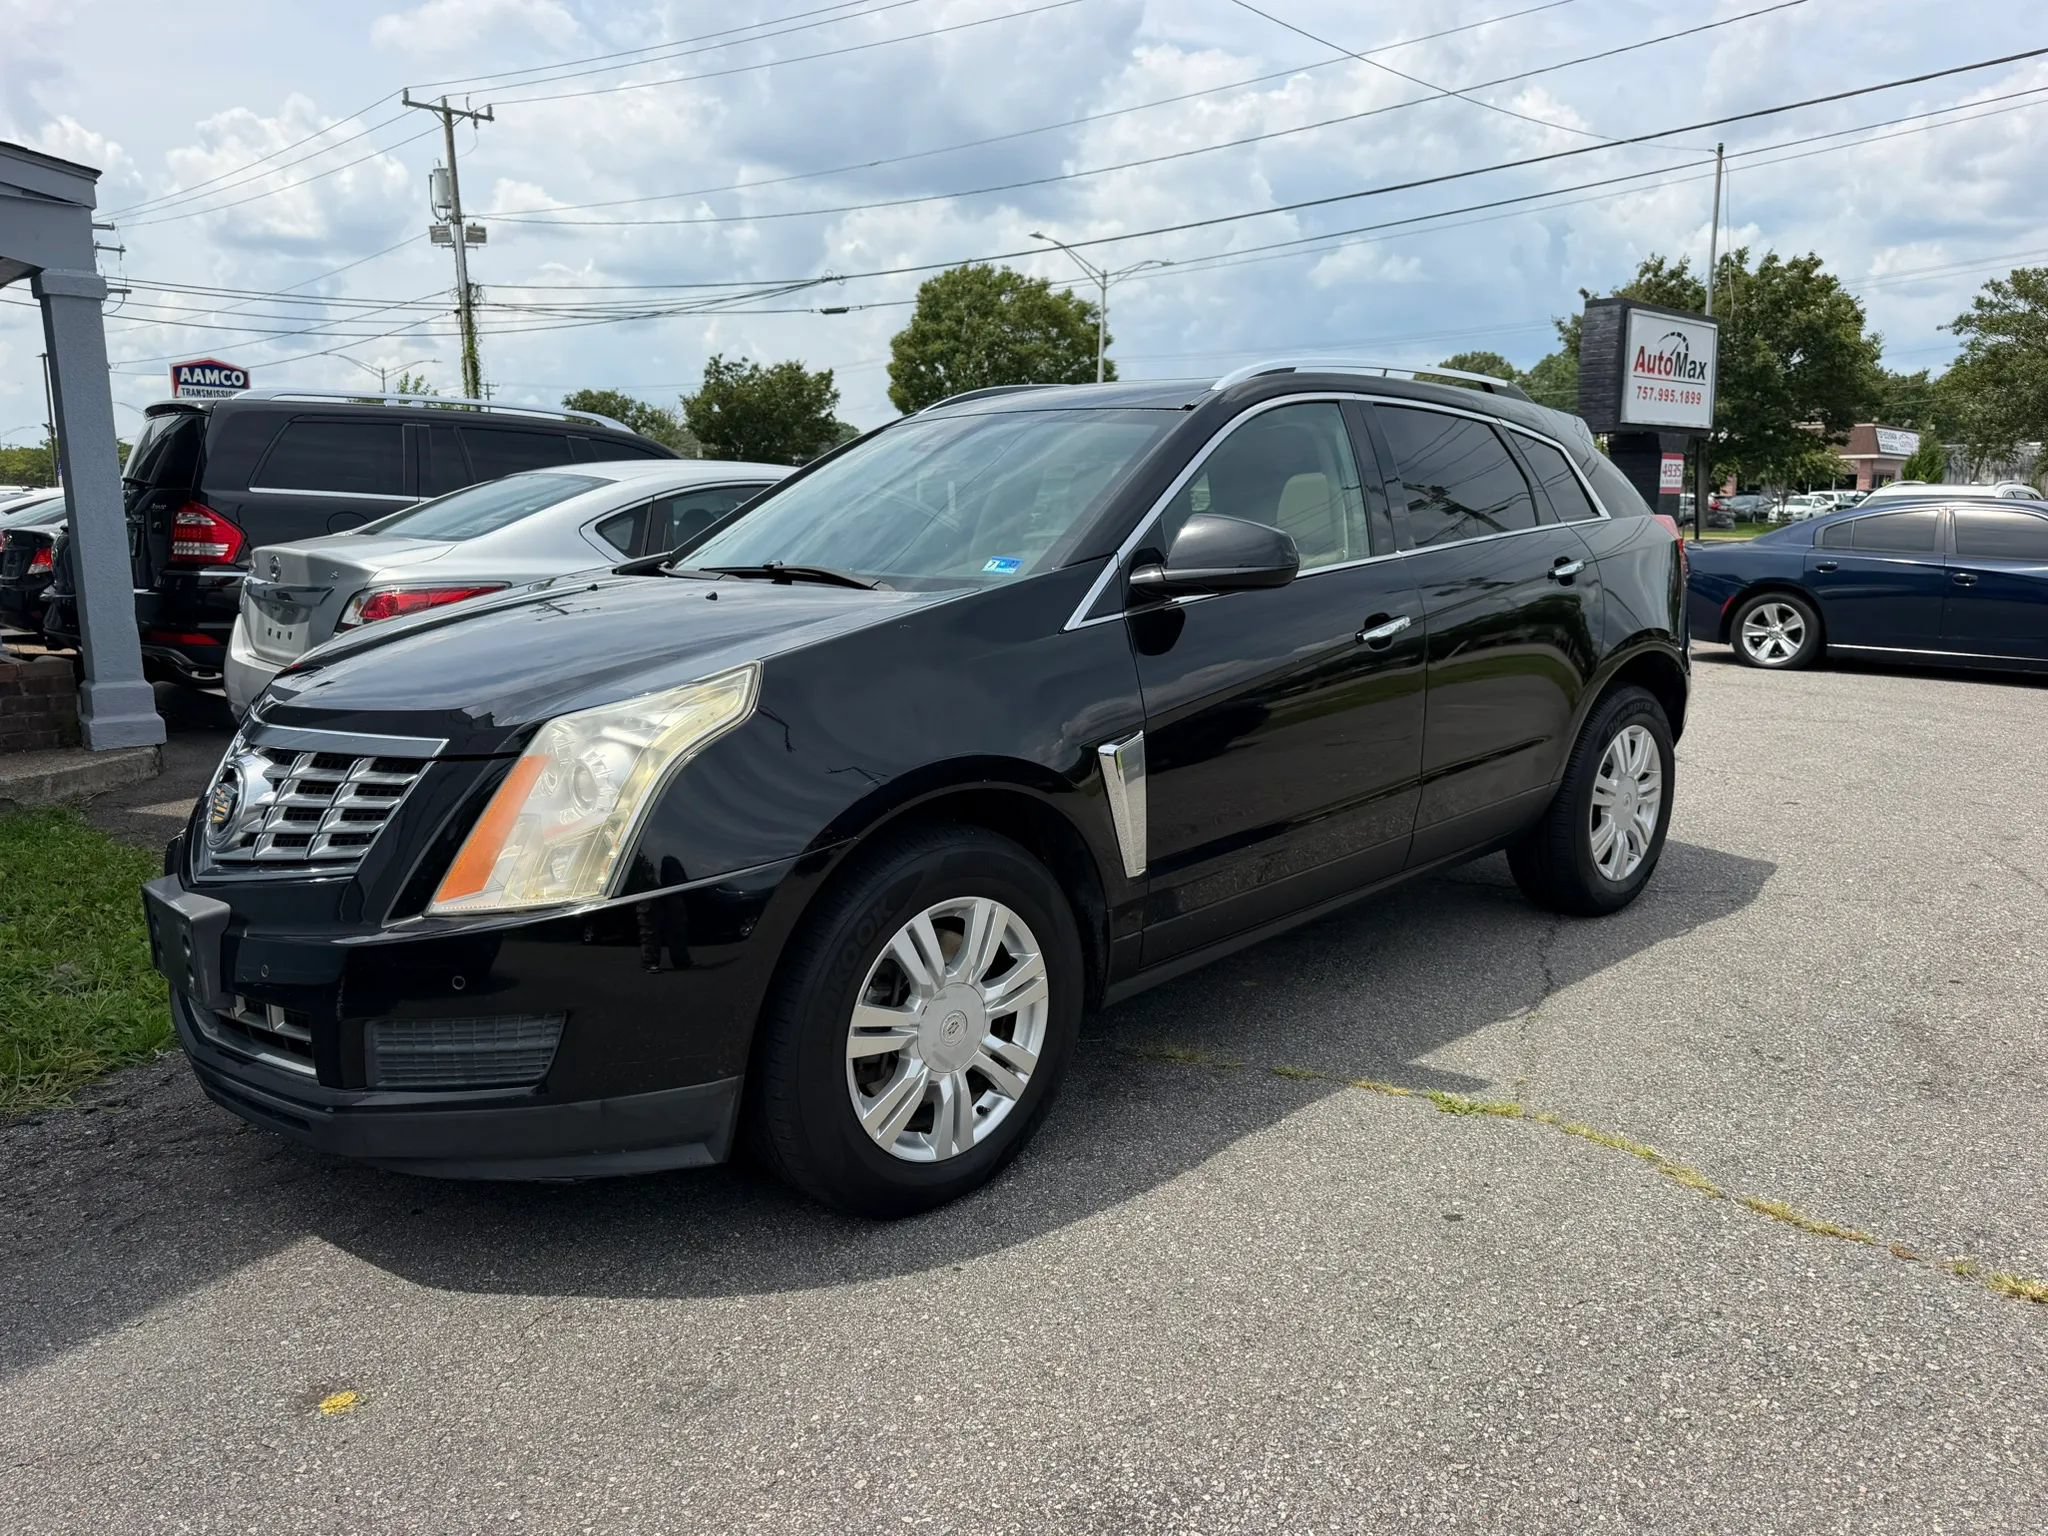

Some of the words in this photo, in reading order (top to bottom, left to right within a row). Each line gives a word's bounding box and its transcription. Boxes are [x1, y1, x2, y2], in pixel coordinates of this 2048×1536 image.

[1633, 346, 1707, 380] AutoMax
[180, 367, 244, 386] AAMCO
[181, 387, 237, 398] TRANSMISSIO
[1637, 386, 1702, 405] 757.995.1899
[1662, 463, 1682, 477] 4935
